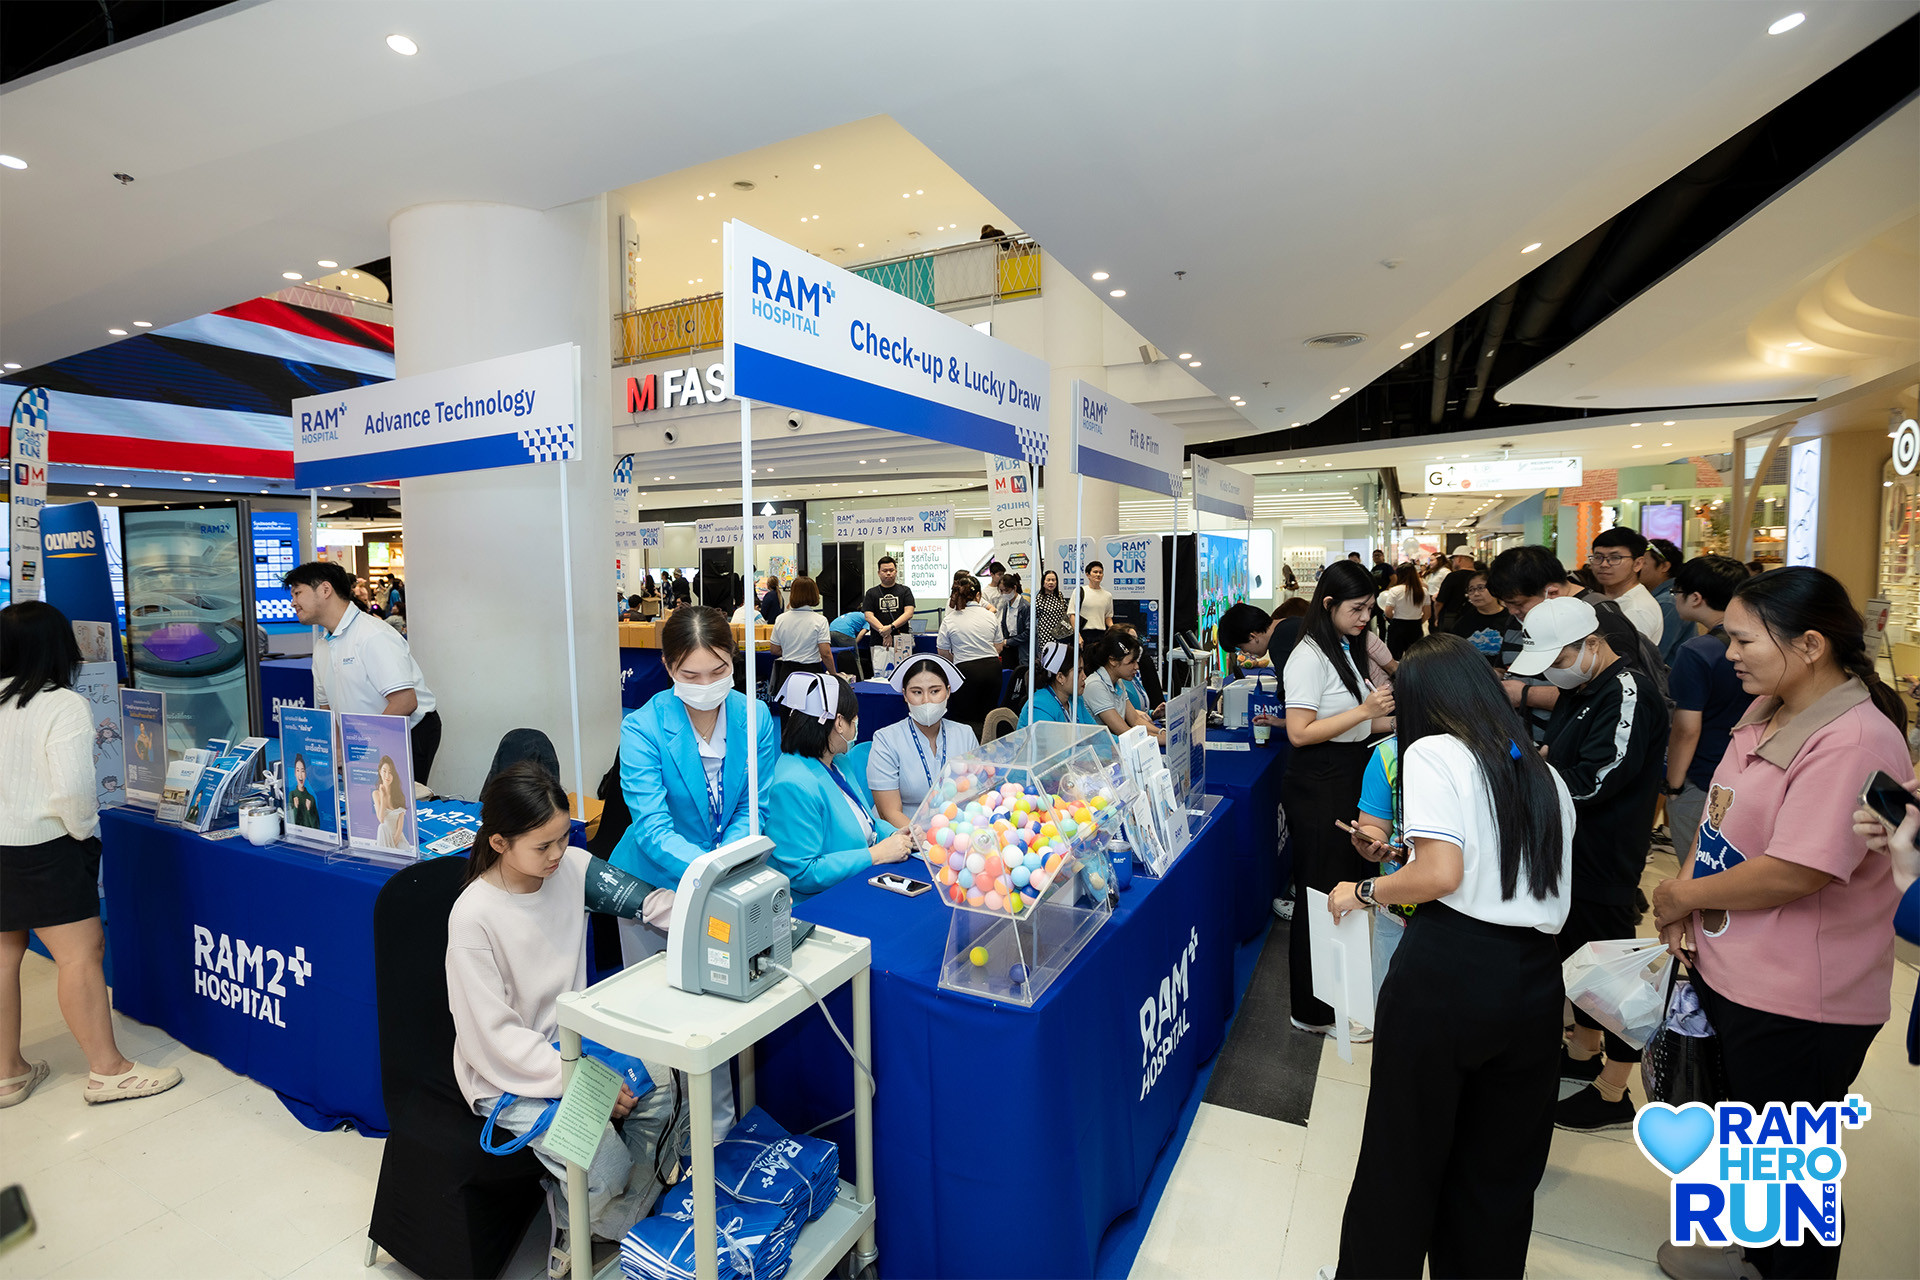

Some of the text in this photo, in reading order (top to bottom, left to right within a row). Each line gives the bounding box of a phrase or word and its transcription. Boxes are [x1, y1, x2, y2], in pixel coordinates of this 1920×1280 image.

[752, 256, 820, 317] RAM
[752, 298, 820, 337] HOSPITAL
[850, 319, 1042, 412] Check-up & Lucky Draw
[627, 374, 656, 413] M
[364, 389, 536, 435] Advance Technology
[1082, 397, 1104, 424] RAM
[301, 409, 338, 433] RAM
[1082, 420, 1103, 435] HOSPITAL
[301, 430, 339, 445] HOSPITAL
[1130, 428, 1160, 455] Fit & Firm
[1429, 471, 1443, 486] G
[200, 524, 226, 534] RAM2
[772, 530, 791, 539] RUN
[838, 528, 848, 536] 21
[858, 527, 868, 536] 10
[877, 526, 883, 534] 5
[892, 526, 898, 534] 3
[900, 525, 914, 534] KM
[924, 522, 946, 532] RUN
[44, 530, 96, 551] OLYMPUS
[643, 538, 658, 546] RUN
[733, 534, 738, 542] 5
[1122, 541, 1146, 551] RAM
[1122, 551, 1147, 559] HERO
[1113, 560, 1145, 573] RUN
[911, 572, 935, 580] สุขภาพ
[911, 580, 937, 588] ของคุณ
[1254, 704, 1278, 714] RAM
[194, 924, 286, 998] RAM2
[194, 969, 286, 1028] HOSPITAL
[1139, 947, 1189, 1068] RAM
[1139, 1008, 1190, 1101] HOSPITAL
